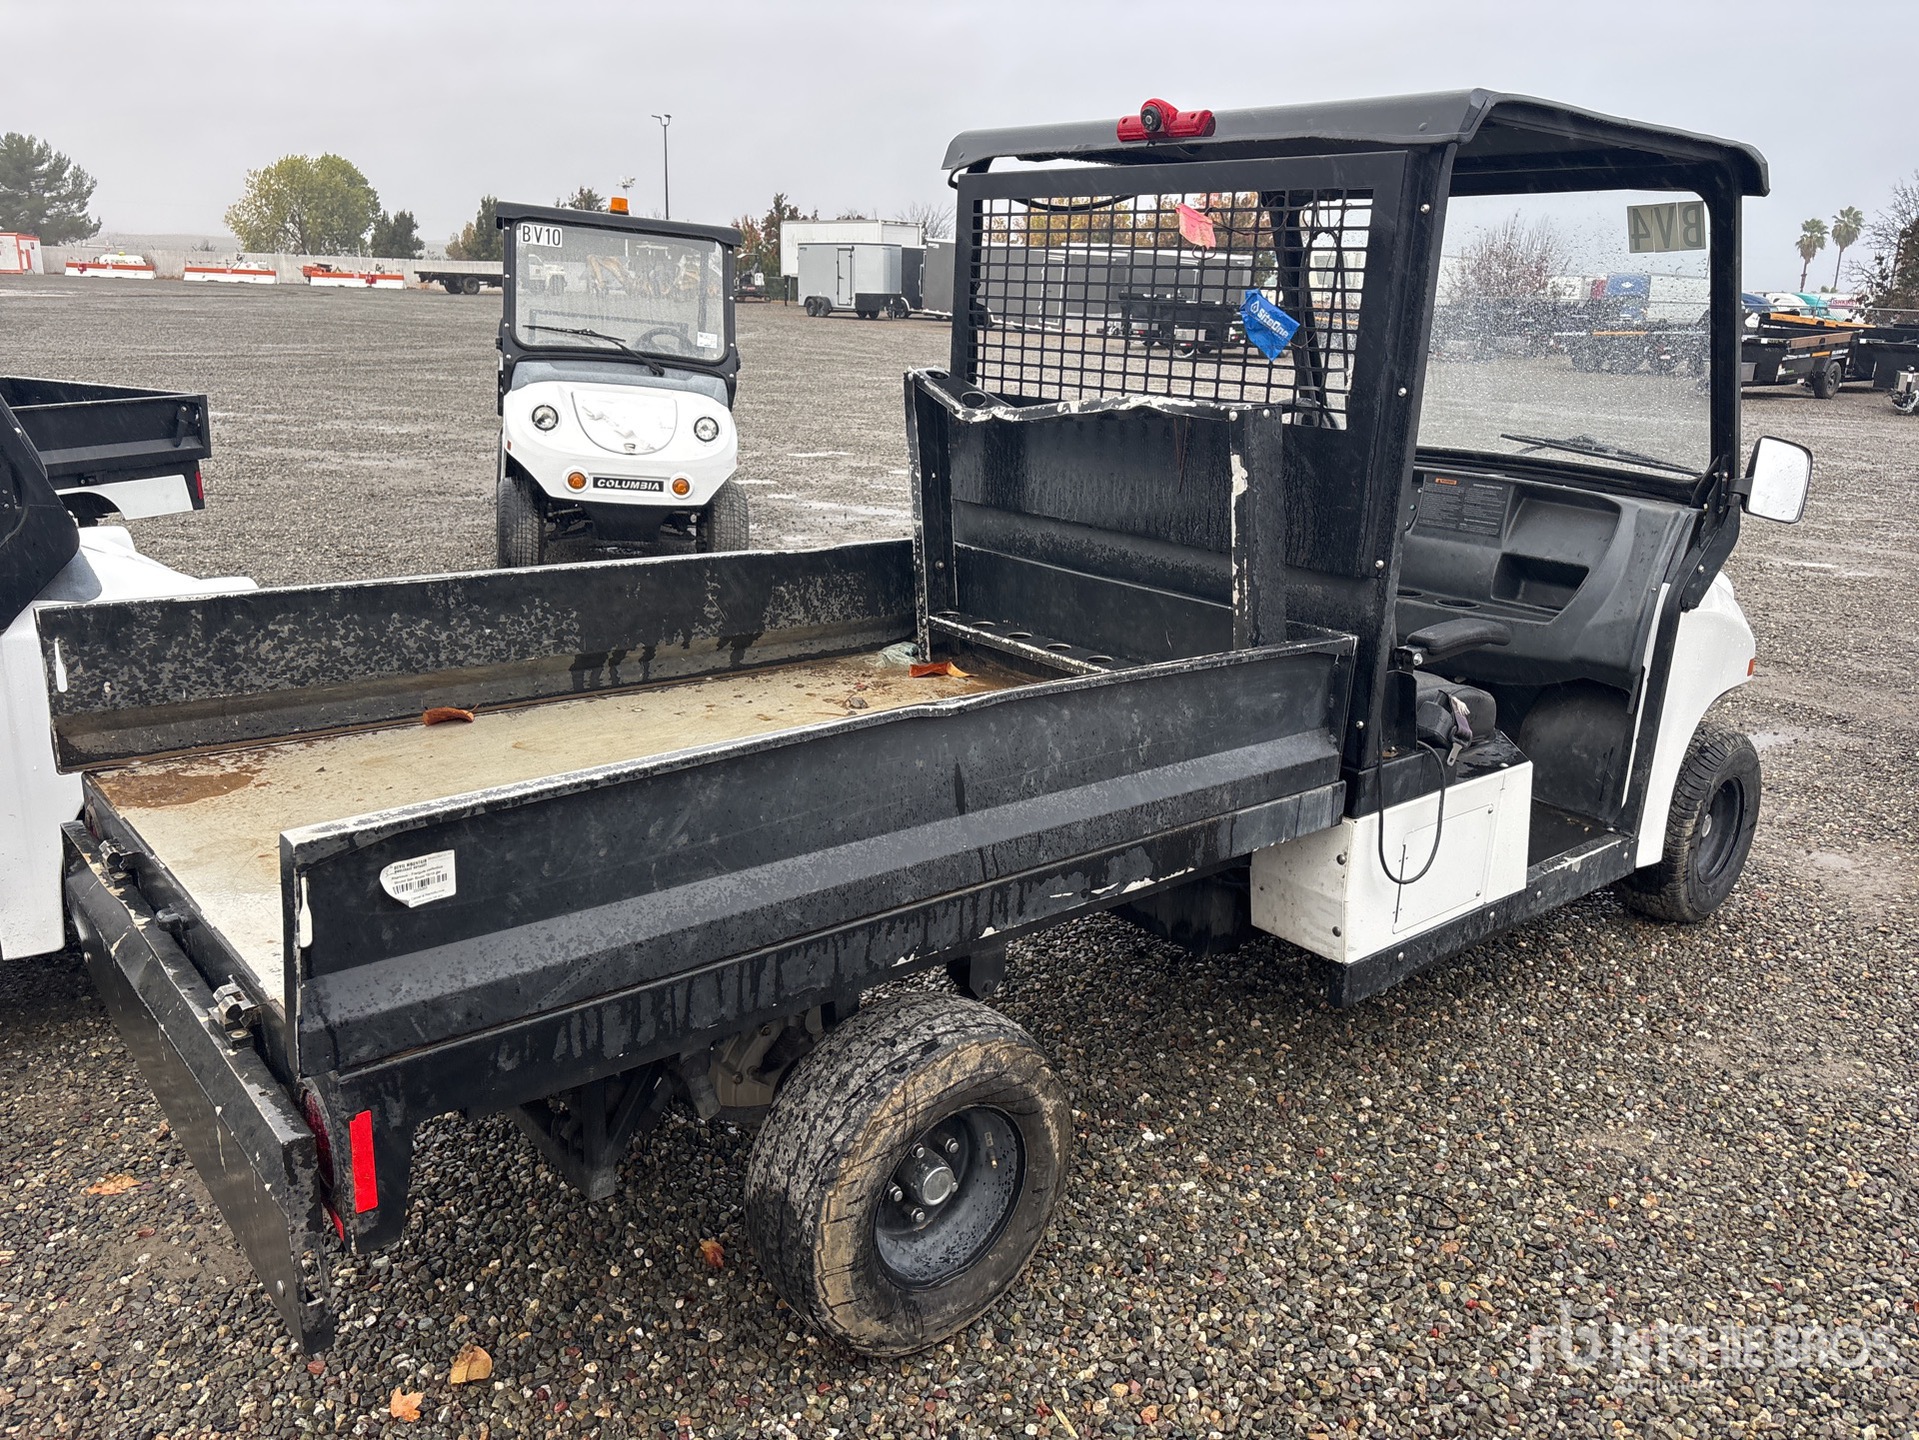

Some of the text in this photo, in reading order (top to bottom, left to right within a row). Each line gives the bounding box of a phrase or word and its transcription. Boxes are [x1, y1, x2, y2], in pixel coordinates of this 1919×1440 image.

[522, 225, 561, 246] BV10
[1257, 308, 1289, 338] SiteOne
[597, 479, 660, 491] COLUMBIA
